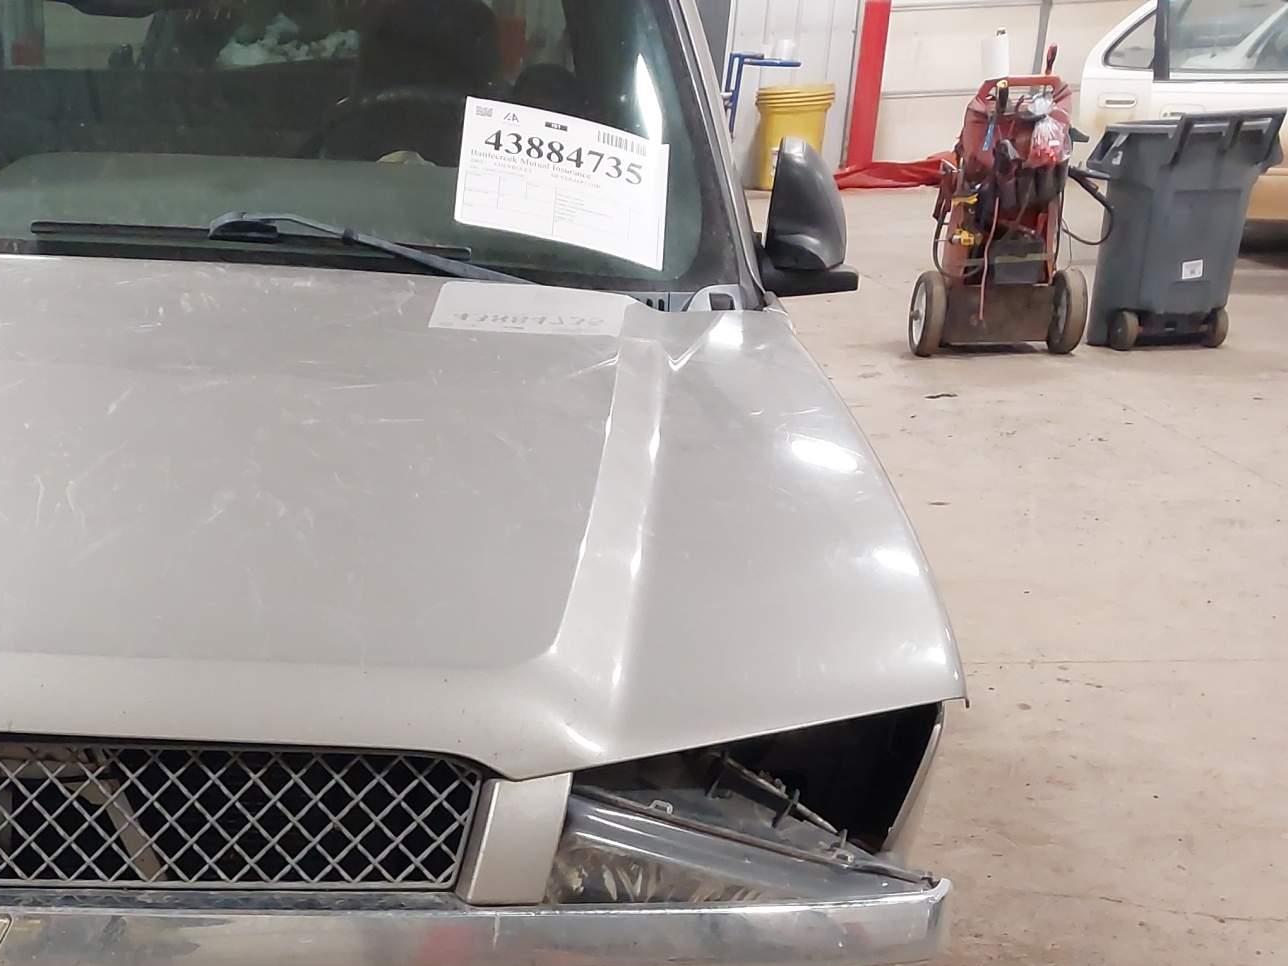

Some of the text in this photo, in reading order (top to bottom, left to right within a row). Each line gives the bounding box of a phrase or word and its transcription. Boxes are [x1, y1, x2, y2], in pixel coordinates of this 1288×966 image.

[484, 129, 643, 185] 43884735
[520, 158, 550, 171] Mutual
[552, 164, 592, 179] Insurance
